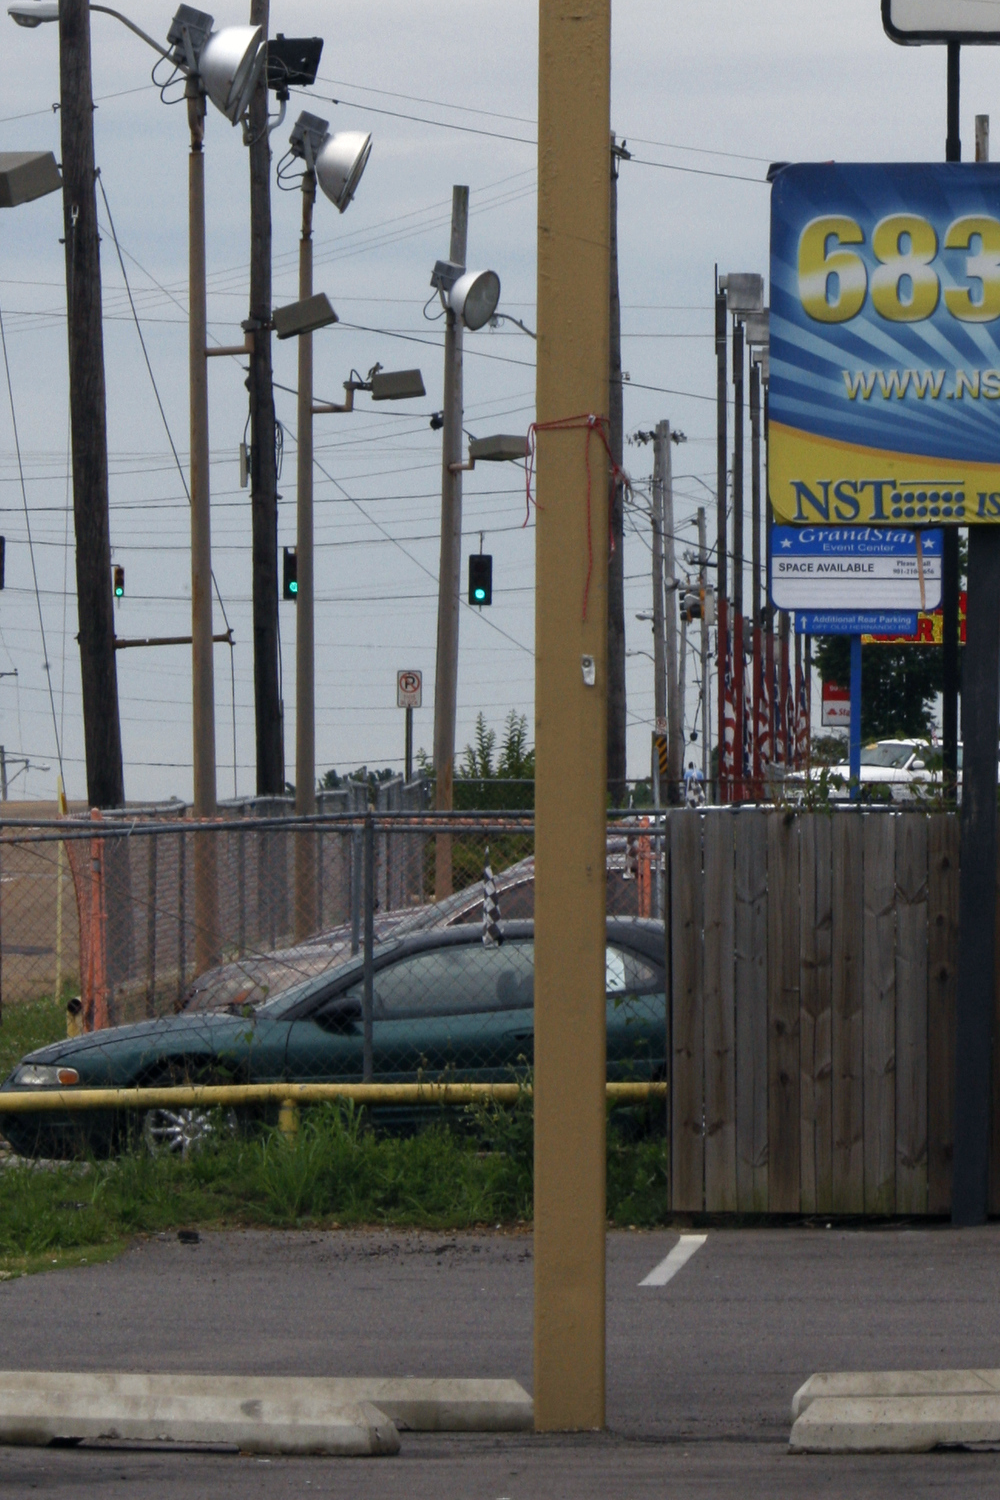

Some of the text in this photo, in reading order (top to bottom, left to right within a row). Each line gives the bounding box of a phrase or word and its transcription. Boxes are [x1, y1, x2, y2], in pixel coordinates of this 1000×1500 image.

[789, 479, 897, 521] NST
[798, 528, 917, 544] GrandStar
[822, 544, 895, 552] Event Center
[778, 563, 875, 573] SPACE AVAILABLE
[812, 615, 911, 625] Additional Rear Parking
